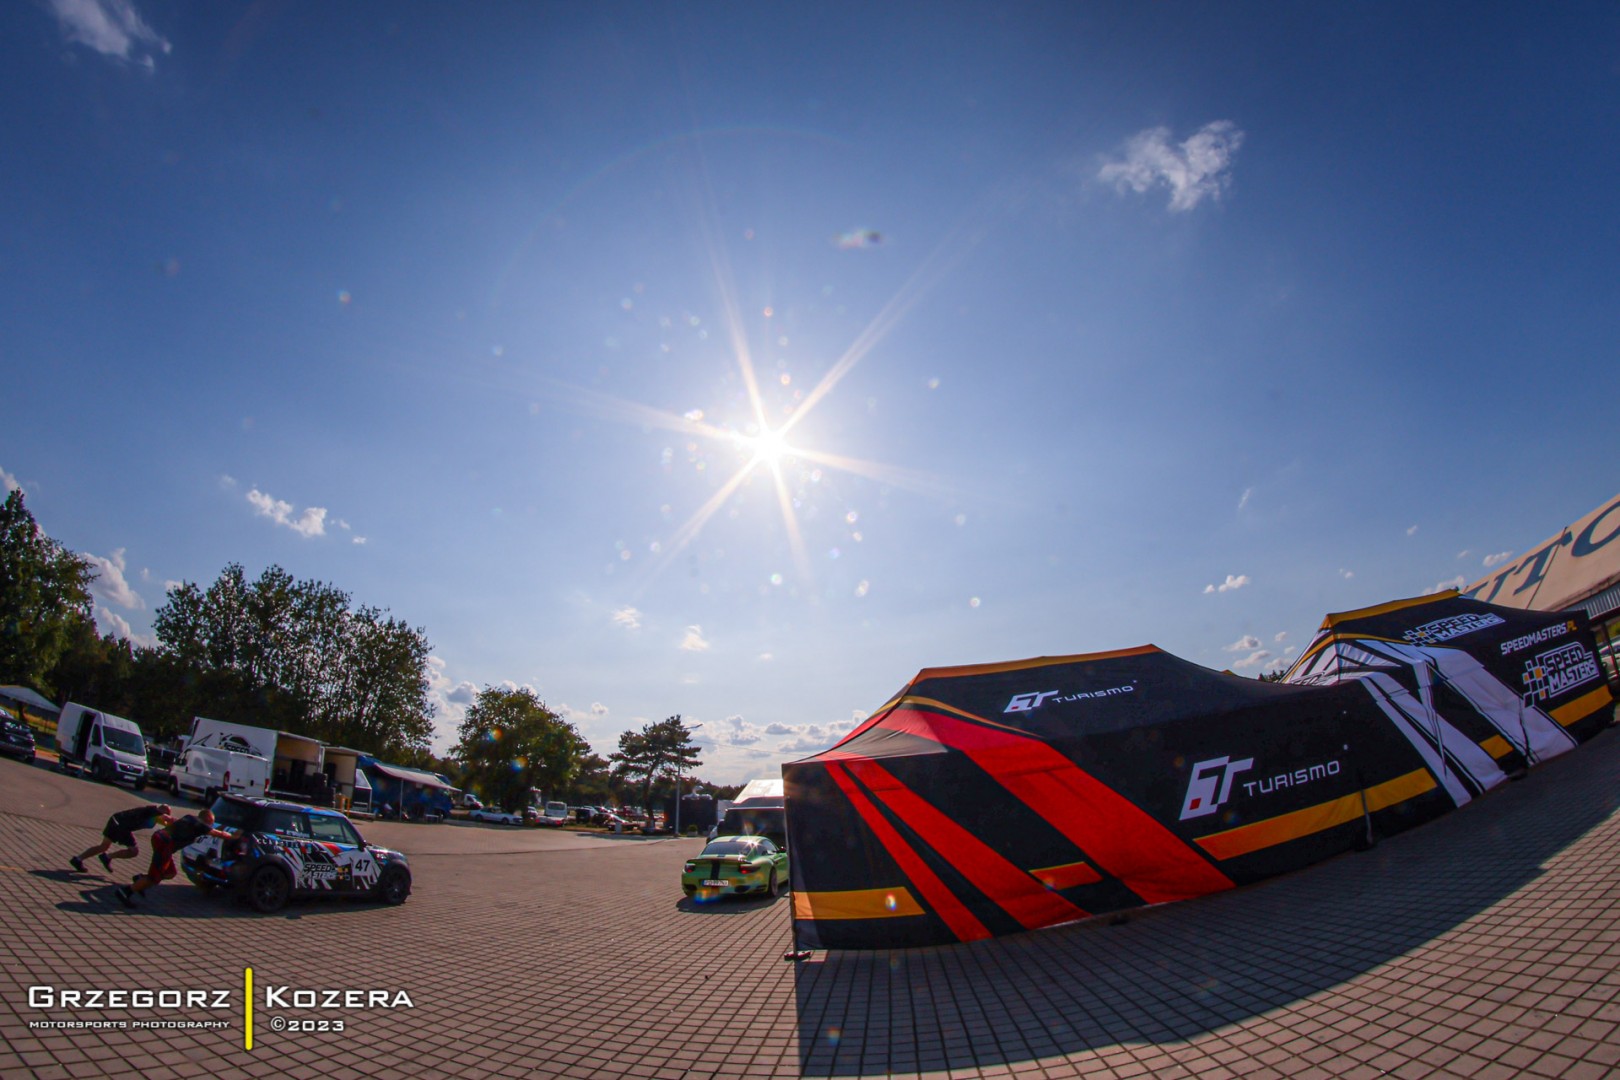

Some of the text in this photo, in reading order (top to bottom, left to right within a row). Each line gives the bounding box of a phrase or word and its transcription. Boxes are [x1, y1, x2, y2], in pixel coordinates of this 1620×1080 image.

[1427, 614, 1480, 633] SPEED
[1436, 615, 1498, 640] MASTERS
[1500, 620, 1578, 655] SPEEDMASTERS.PL
[1543, 646, 1584, 672] SPEED
[1547, 660, 1597, 692] MASTERS
[1052, 685, 1134, 704] TURISMO
[1243, 760, 1340, 797] TURISMO
[303, 863, 333, 873] SPEED
[355, 859, 371, 872] 47
